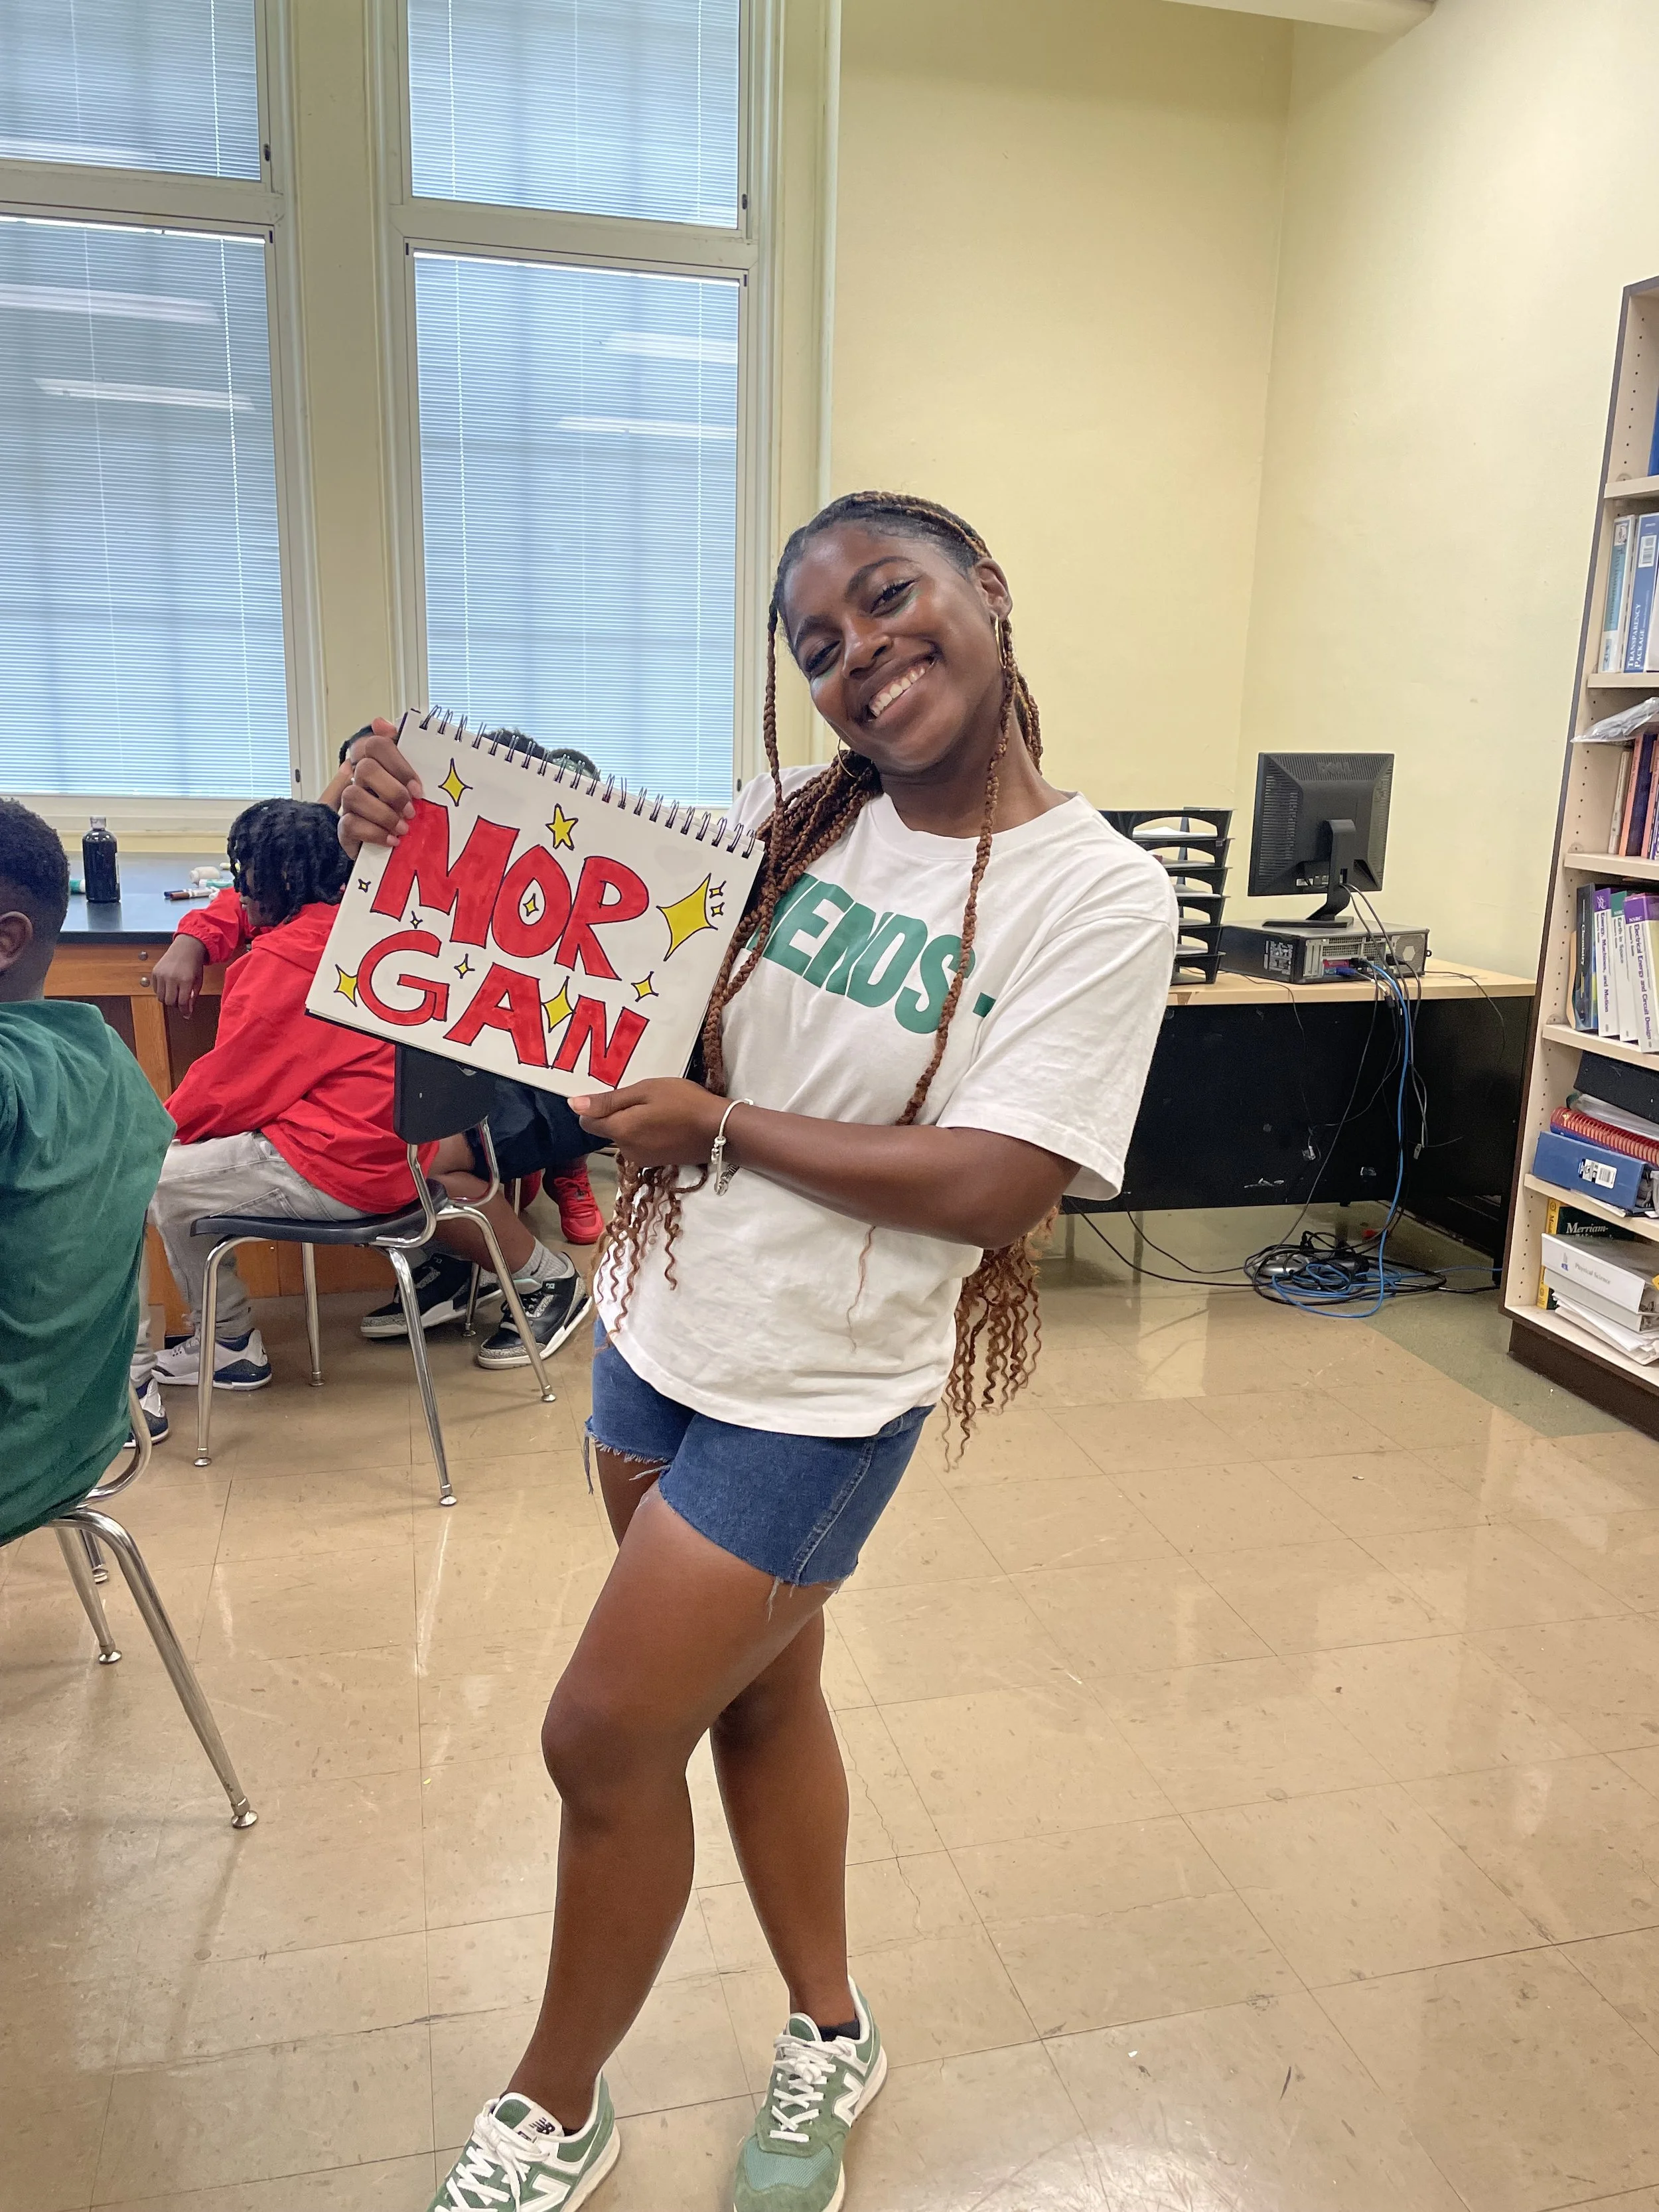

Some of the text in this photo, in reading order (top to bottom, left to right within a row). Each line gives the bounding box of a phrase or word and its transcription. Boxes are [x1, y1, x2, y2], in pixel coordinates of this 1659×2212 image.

[1627, 604, 1641, 668] TRANSPARENCY
[1634, 628, 1645, 668] PACKAGE
[370, 797, 650, 981] MOR
[357, 930, 650, 1090] GAN
[1566, 1222, 1608, 1234] Merriam-
[1575, 1263, 1611, 1284] Physical Science
